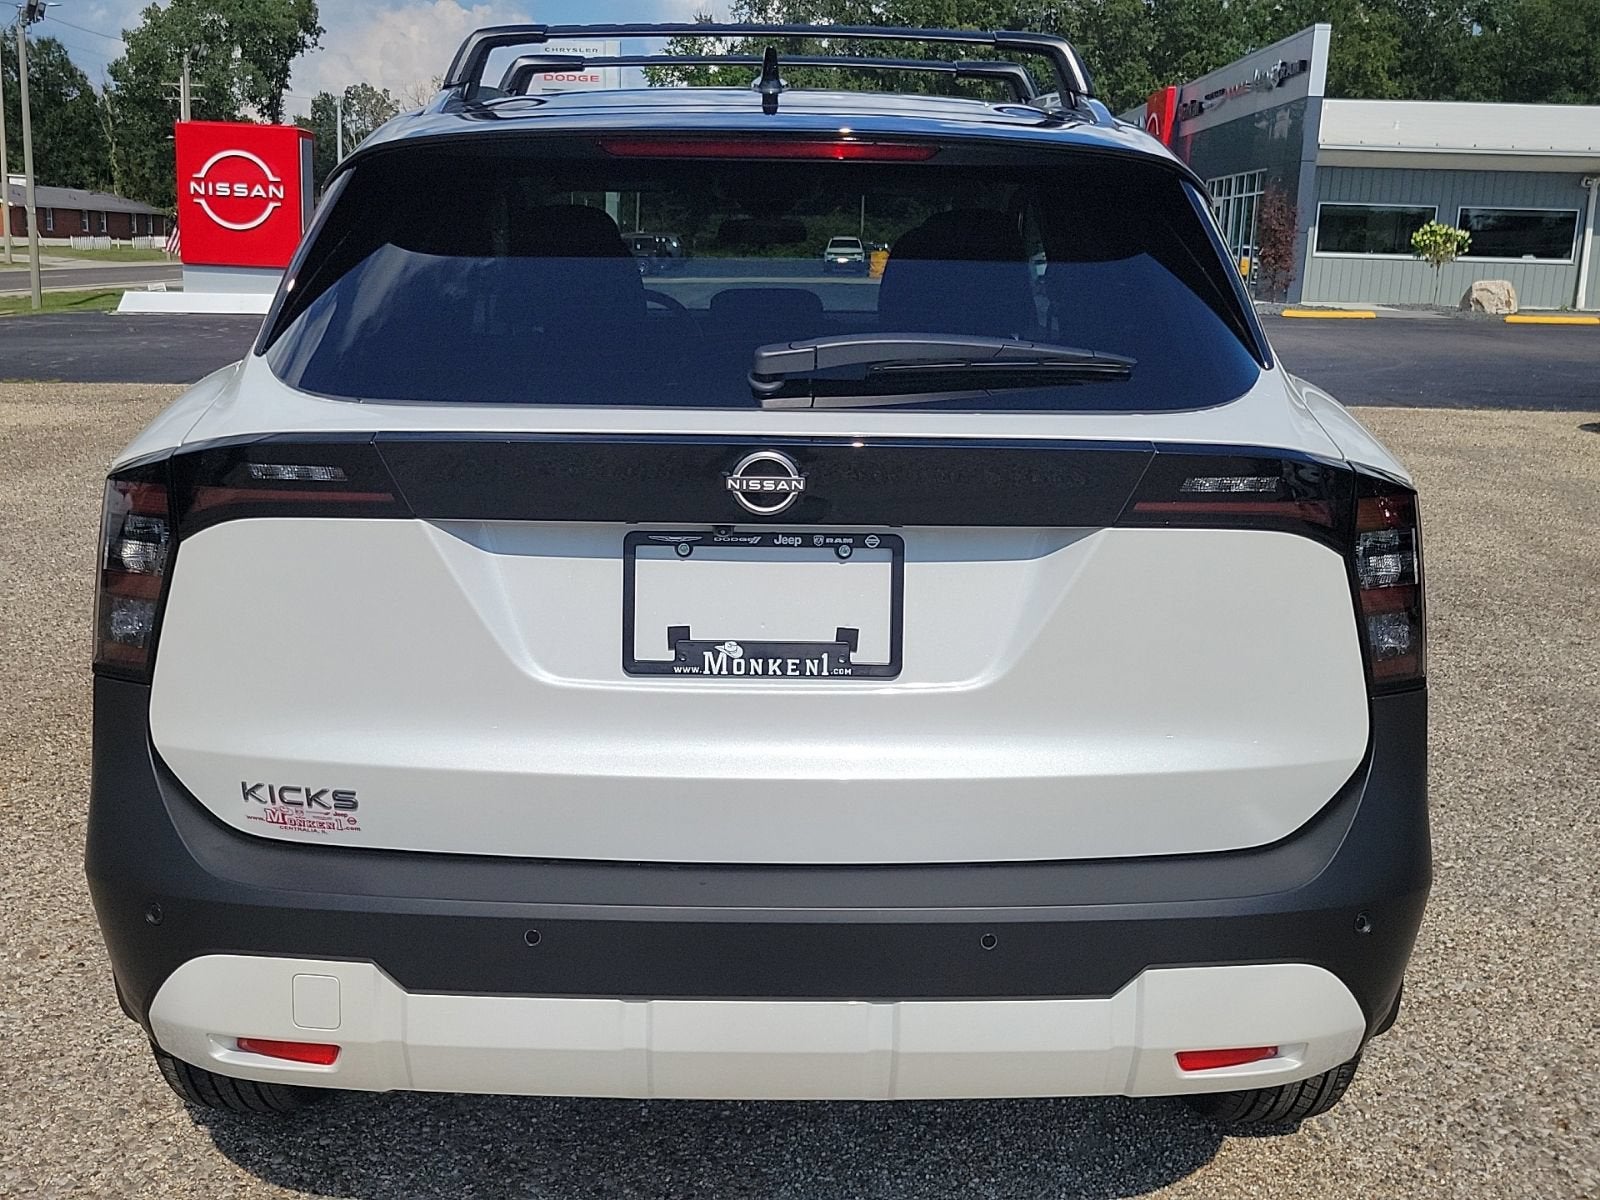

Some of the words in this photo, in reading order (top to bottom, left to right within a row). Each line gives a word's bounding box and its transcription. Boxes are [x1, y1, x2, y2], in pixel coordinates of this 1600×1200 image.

[543, 74, 600, 83] DODGE
[189, 181, 284, 199] NISSAN
[727, 479, 804, 491] NISSAN
[773, 534, 802, 547] Jeep
[241, 781, 358, 812] KICKS
